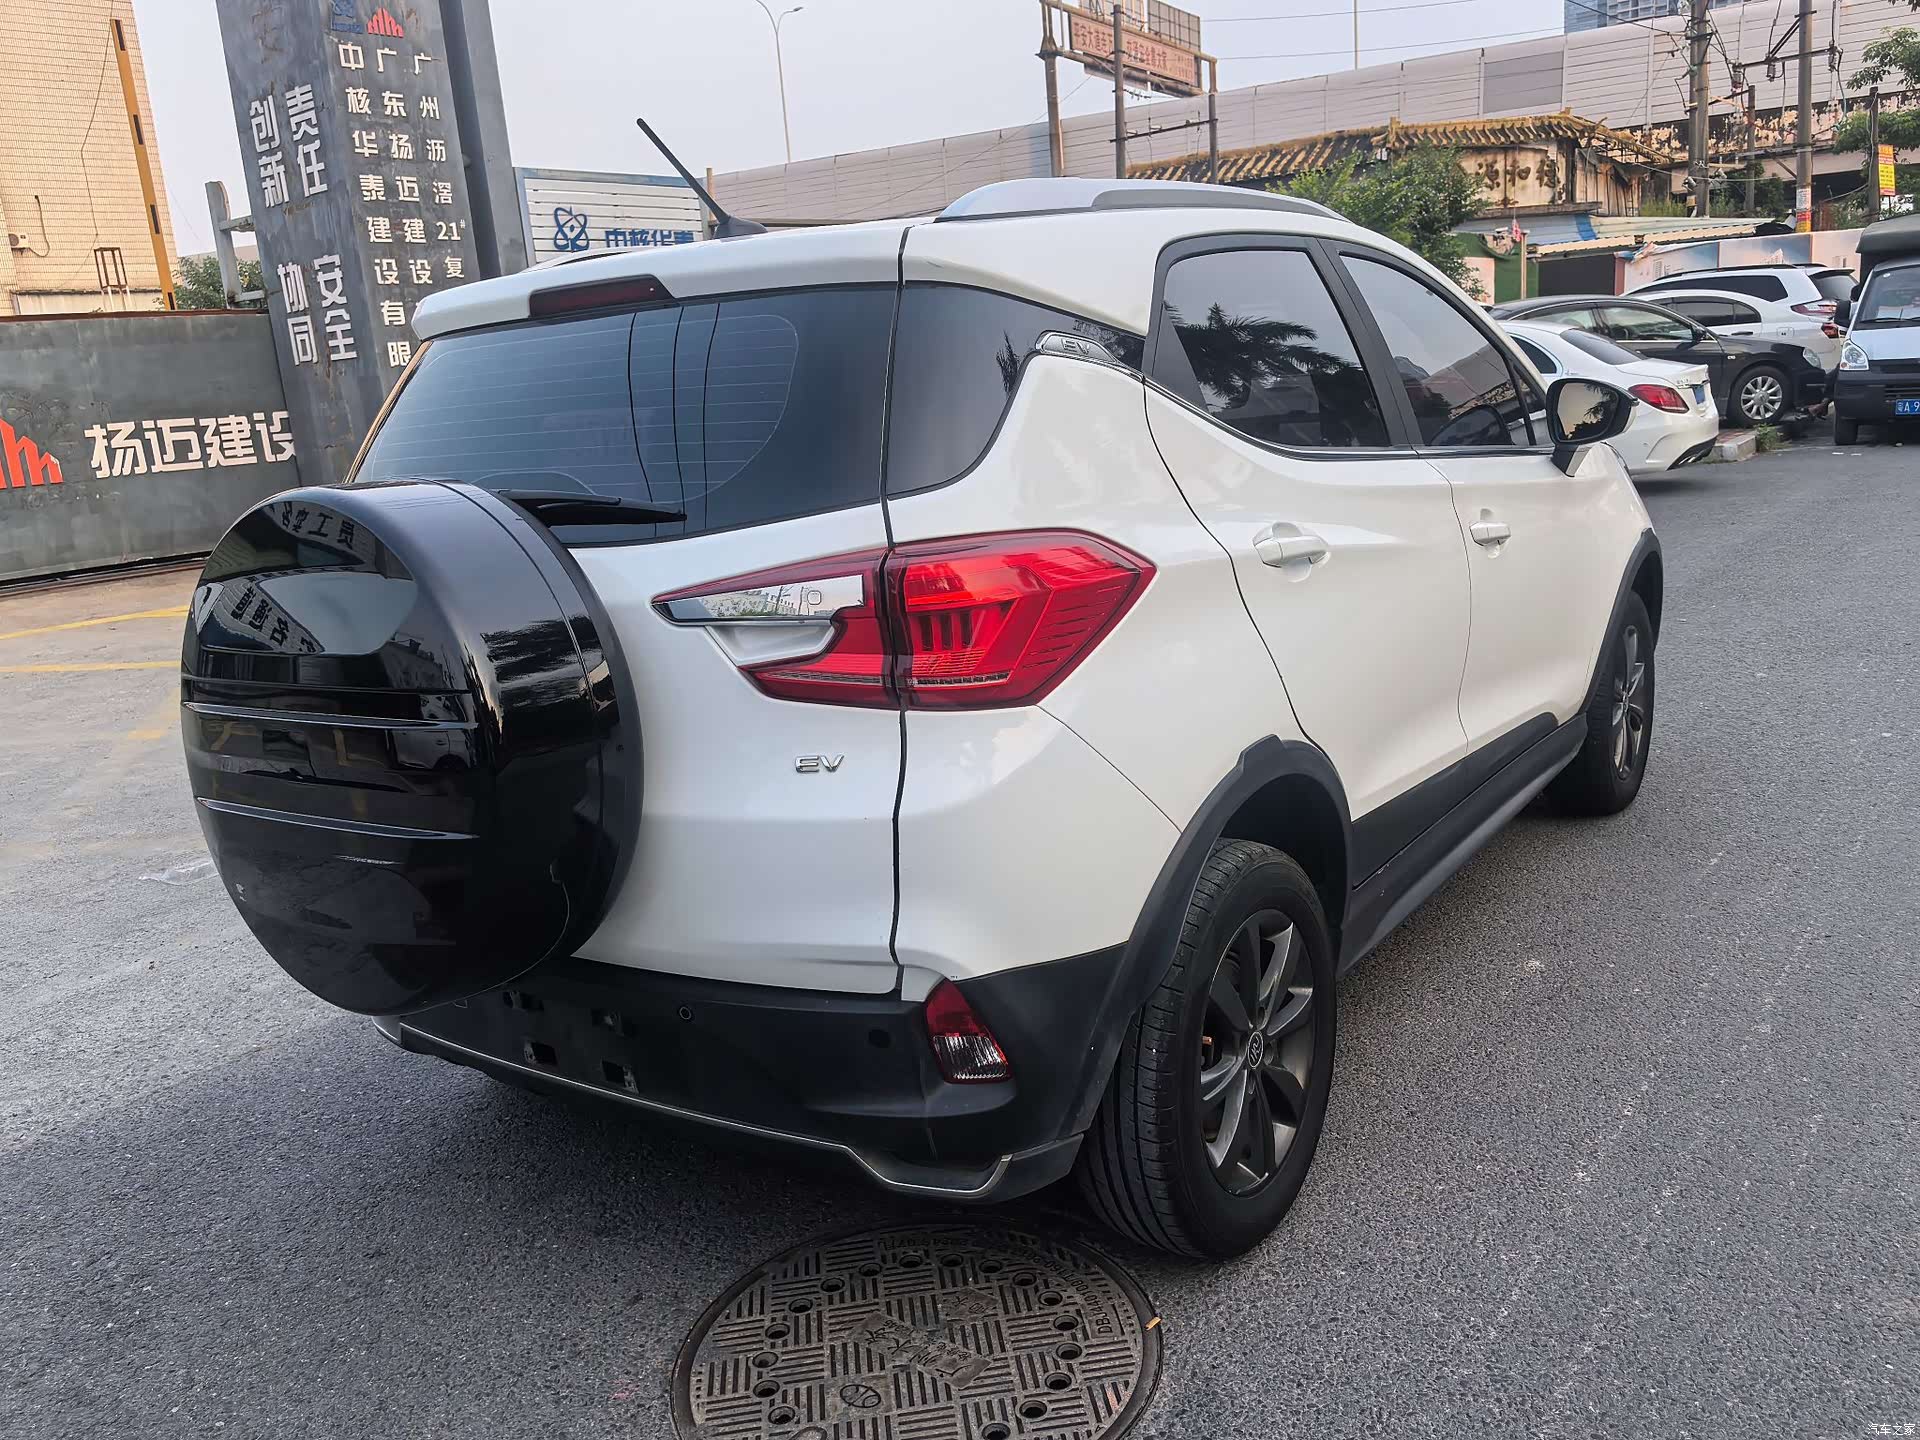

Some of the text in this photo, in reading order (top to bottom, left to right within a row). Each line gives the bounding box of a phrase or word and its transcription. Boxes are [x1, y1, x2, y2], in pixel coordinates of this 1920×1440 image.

[249, 95, 290, 208] 创新
[285, 84, 328, 198] 责任
[276, 261, 319, 367] 协同
[313, 254, 358, 361] 安全
[1060, 338, 1090, 354] EV
[84, 411, 297, 479] 扬迈建设
[795, 754, 845, 773] EV
